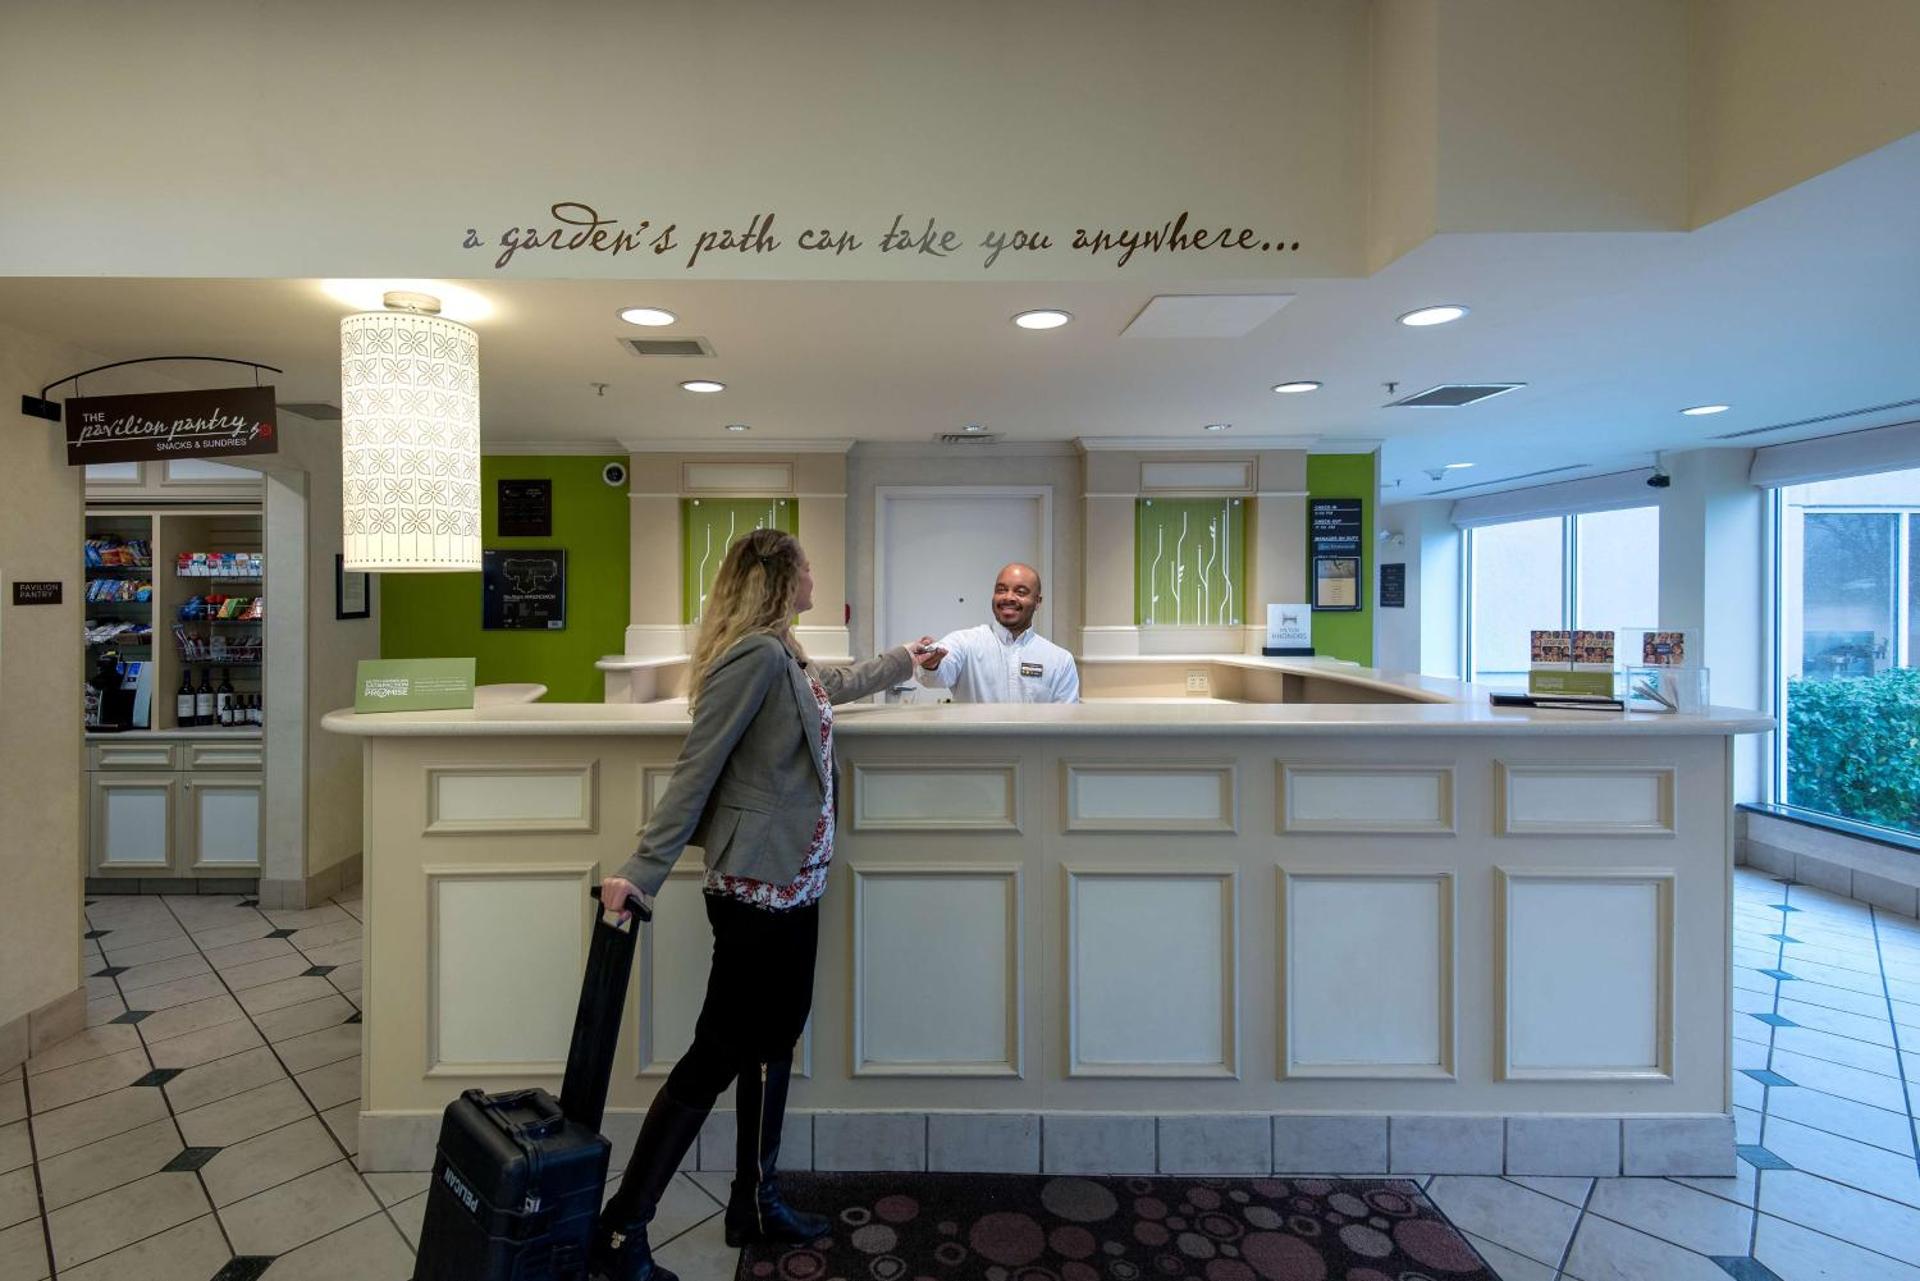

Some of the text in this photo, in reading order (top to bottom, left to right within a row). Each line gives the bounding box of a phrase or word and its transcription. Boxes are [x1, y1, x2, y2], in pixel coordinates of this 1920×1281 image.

[463, 202, 1300, 269] a garden's path can take you anywhere...
[83, 412, 105, 423] THE
[76, 407, 248, 448] pavilion pantry
[156, 438, 247, 451] SNACKS & SUNDRIES
[19, 584, 59, 592] PAVILION
[19, 590, 54, 599] PANTRY
[364, 687, 409, 699] PROMISE
[444, 1167, 479, 1213] PELICAN
